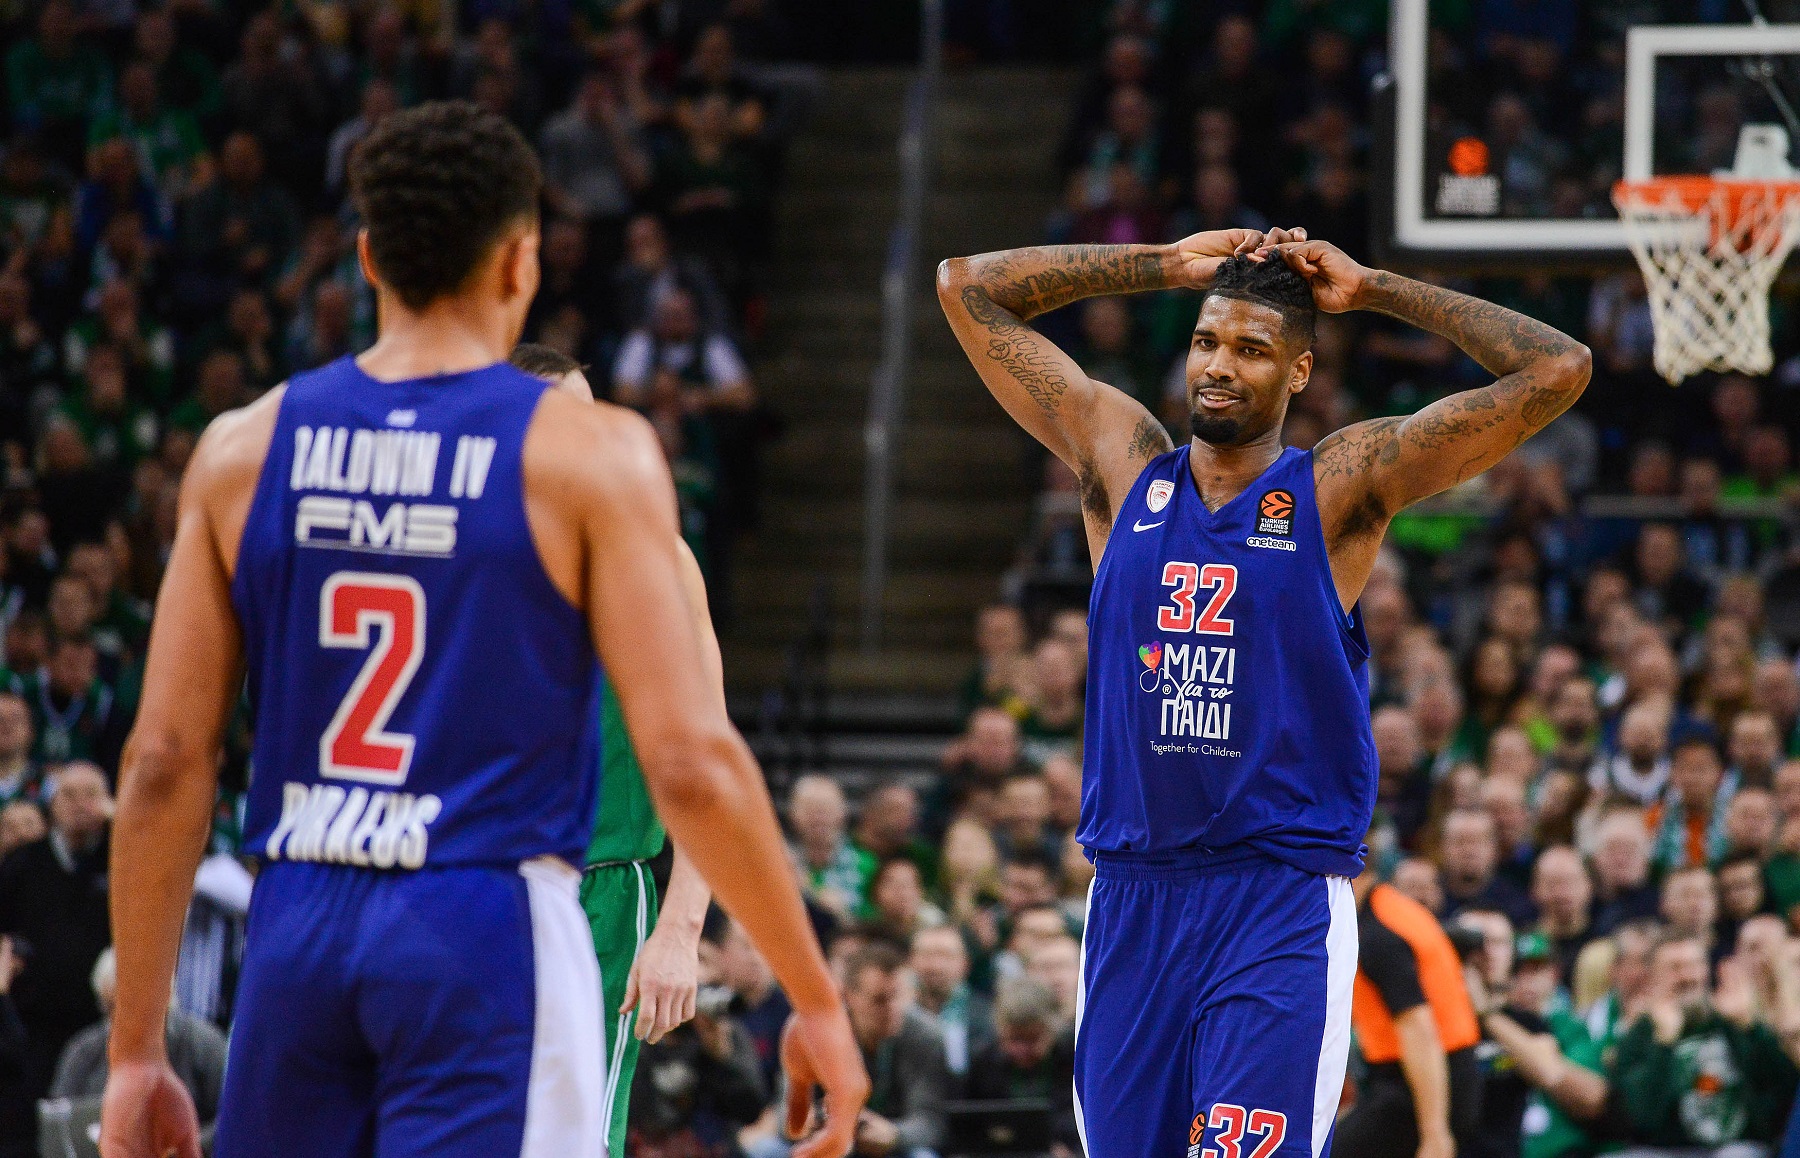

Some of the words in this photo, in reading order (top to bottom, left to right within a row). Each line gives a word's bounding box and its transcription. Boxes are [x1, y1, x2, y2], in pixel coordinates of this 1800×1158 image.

[450, 434, 497, 500] IV
[294, 495, 459, 553] FMS
[1260, 518, 1289, 526] TURKISH
[1260, 522, 1289, 531] AIRLINES
[1157, 561, 1238, 636] 32
[319, 570, 426, 786] 2
[1160, 698, 1231, 740] ΠΑΙΔΙ
[1149, 740, 1186, 756] Together
[1187, 742, 1200, 754] for
[1201, 744, 1242, 758] Children
[1201, 1102, 1288, 1158] 32
